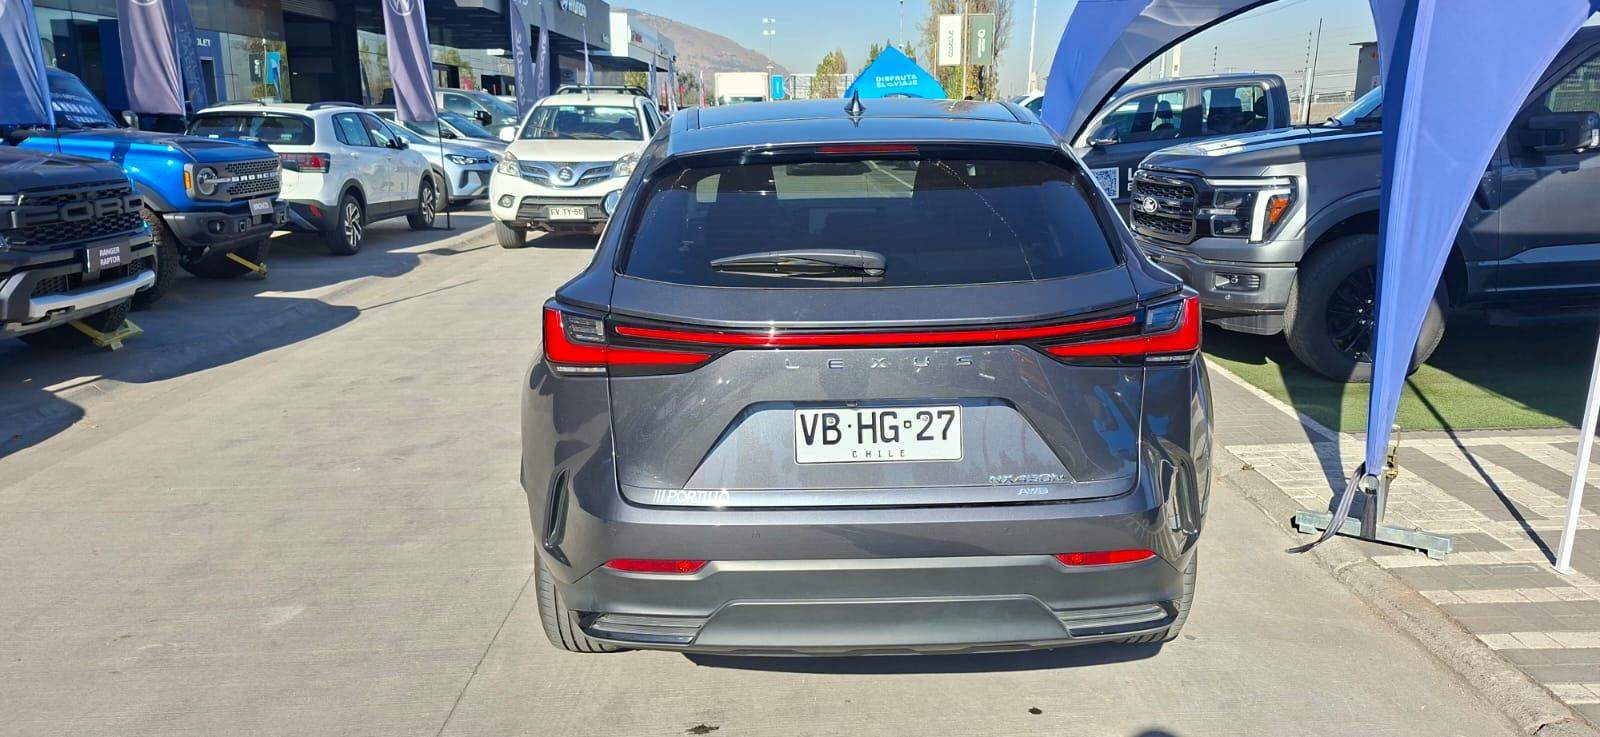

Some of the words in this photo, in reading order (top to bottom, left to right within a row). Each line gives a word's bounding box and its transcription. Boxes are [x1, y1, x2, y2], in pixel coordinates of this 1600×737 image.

[876, 74, 918, 82] DISFRUTA
[99, 246, 120, 256] RANGER
[100, 256, 121, 266] RAPTOR
[785, 357, 973, 370] LEXUS
[852, 449, 906, 458] CHILE
[1016, 487, 1049, 496] AWD
